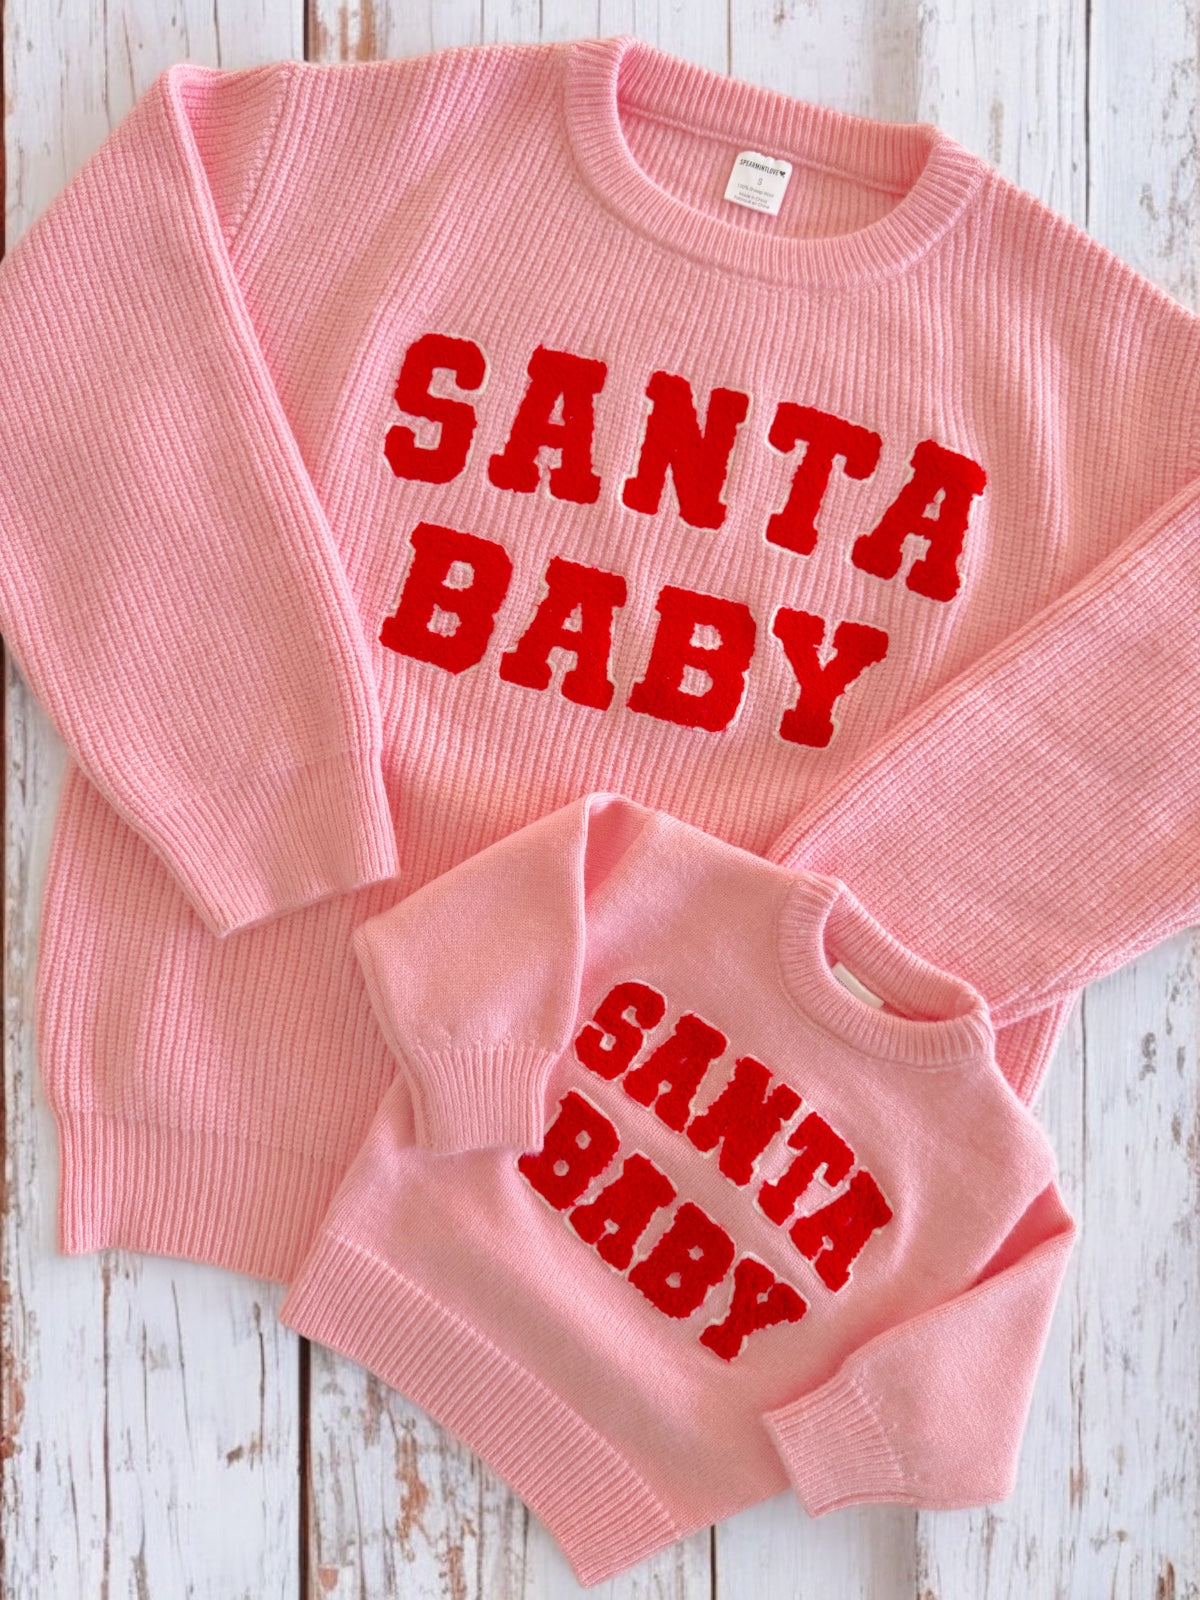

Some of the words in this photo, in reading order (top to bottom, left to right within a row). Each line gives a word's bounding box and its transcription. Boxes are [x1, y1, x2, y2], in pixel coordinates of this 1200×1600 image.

[739, 158, 780, 176] SPEARMINTLOVE
[383, 333, 987, 603] SANTA
[379, 522, 889, 748] BABY
[517, 1091, 807, 1363] BABY
[574, 982, 893, 1293] SANTA
